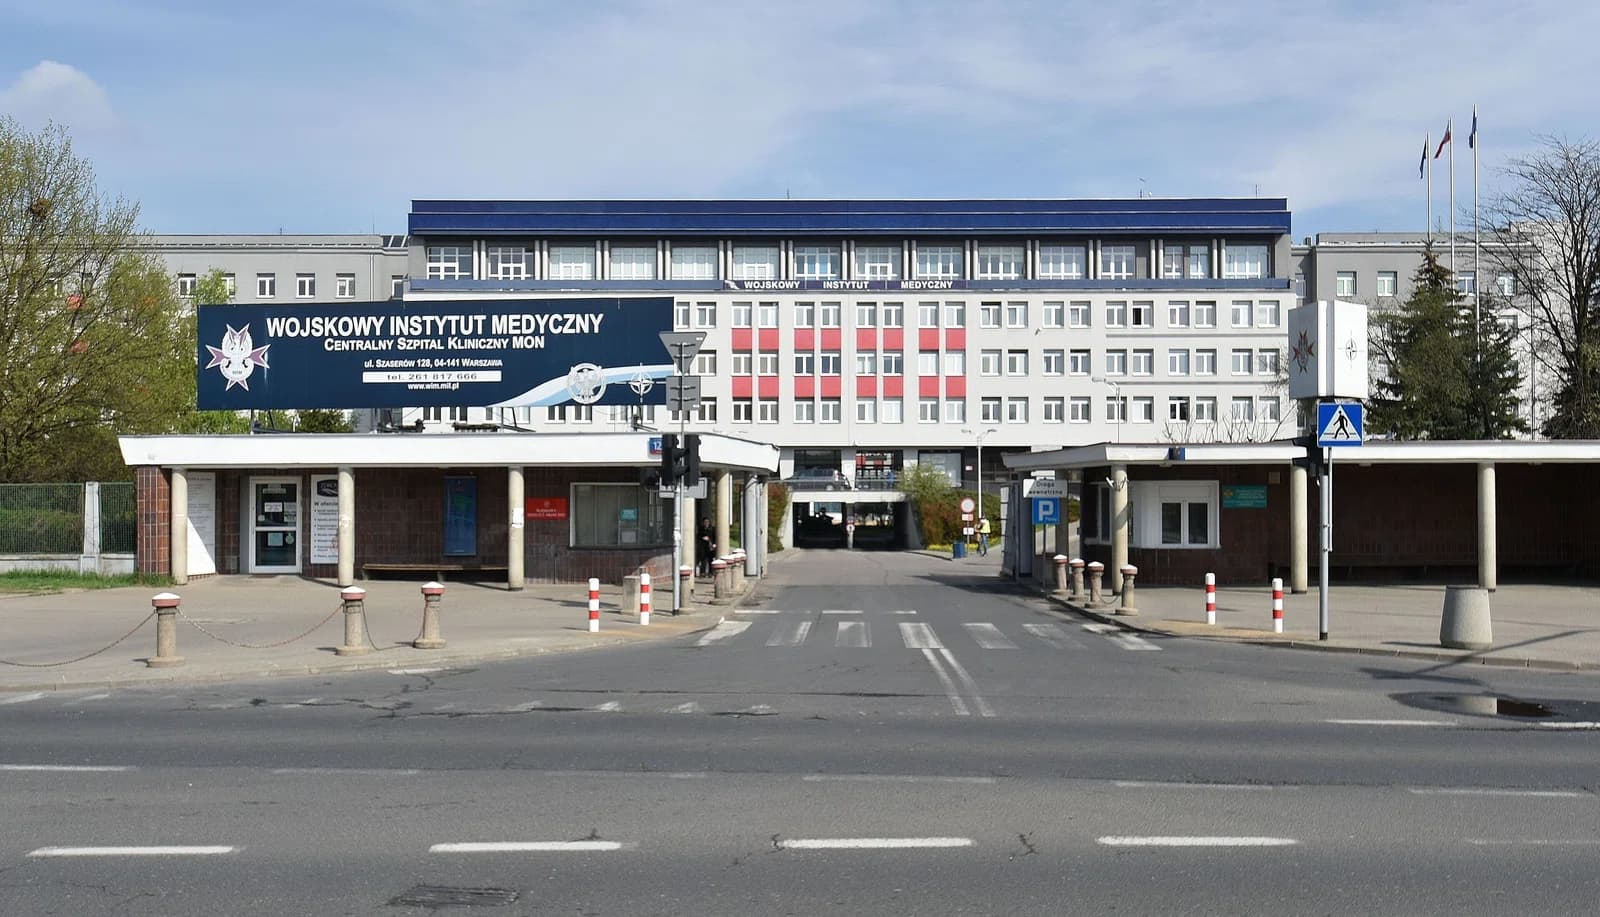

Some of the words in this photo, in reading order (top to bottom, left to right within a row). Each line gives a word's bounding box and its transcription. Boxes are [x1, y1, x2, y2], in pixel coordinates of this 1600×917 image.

[744, 281, 800, 289] WOJSKOWY
[823, 281, 869, 289] INSTYTUT
[901, 280, 953, 289] MEDYCZNY
[266, 316, 385, 338] WOJSKOWY
[390, 315, 487, 336] INSTYTUT
[491, 313, 604, 335] MEDYCZNY
[512, 335, 545, 349] MON
[364, 360, 375, 368] ul.
[416, 358, 433, 369] 128,
[434, 358, 460, 367] 04-141
[387, 373, 405, 381] tel.
[408, 373, 428, 381] 261
[432, 373, 452, 381] 817
[456, 372, 477, 380] 666
